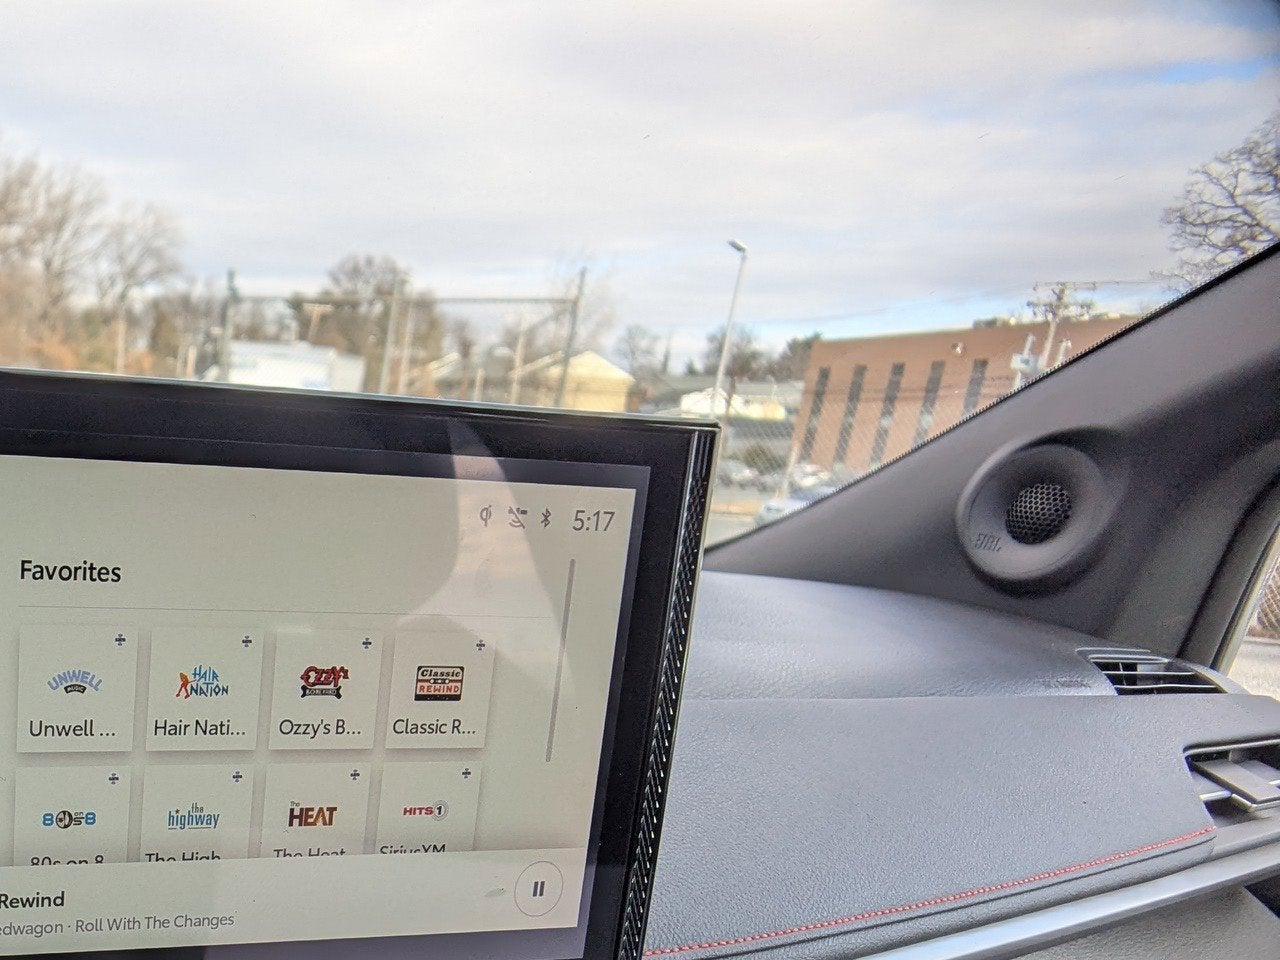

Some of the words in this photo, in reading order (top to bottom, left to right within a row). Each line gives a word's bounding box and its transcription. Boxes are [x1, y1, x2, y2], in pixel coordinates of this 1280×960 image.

[572, 509, 615, 531] 5:17
[19, 559, 122, 584] Favorites
[47, 669, 102, 691] UNWELL
[192, 664, 220, 682] HAIR
[420, 669, 461, 678] Classic
[190, 681, 229, 697] NATION
[419, 685, 460, 694] REWIND
[29, 719, 95, 737] Unwell
[154, 719, 190, 736] Hair
[194, 719, 246, 736] Nati...
[279, 718, 331, 739] Ozzy's
[392, 718, 448, 735] Classic
[191, 802, 204, 813] the
[288, 806, 337, 827] HEAT
[403, 806, 434, 816] HITS
[168, 810, 220, 829] highway
[75, 918, 104, 933] Roll
[107, 916, 141, 931] With
[144, 915, 170, 930] The
[173, 913, 235, 929] Changes
